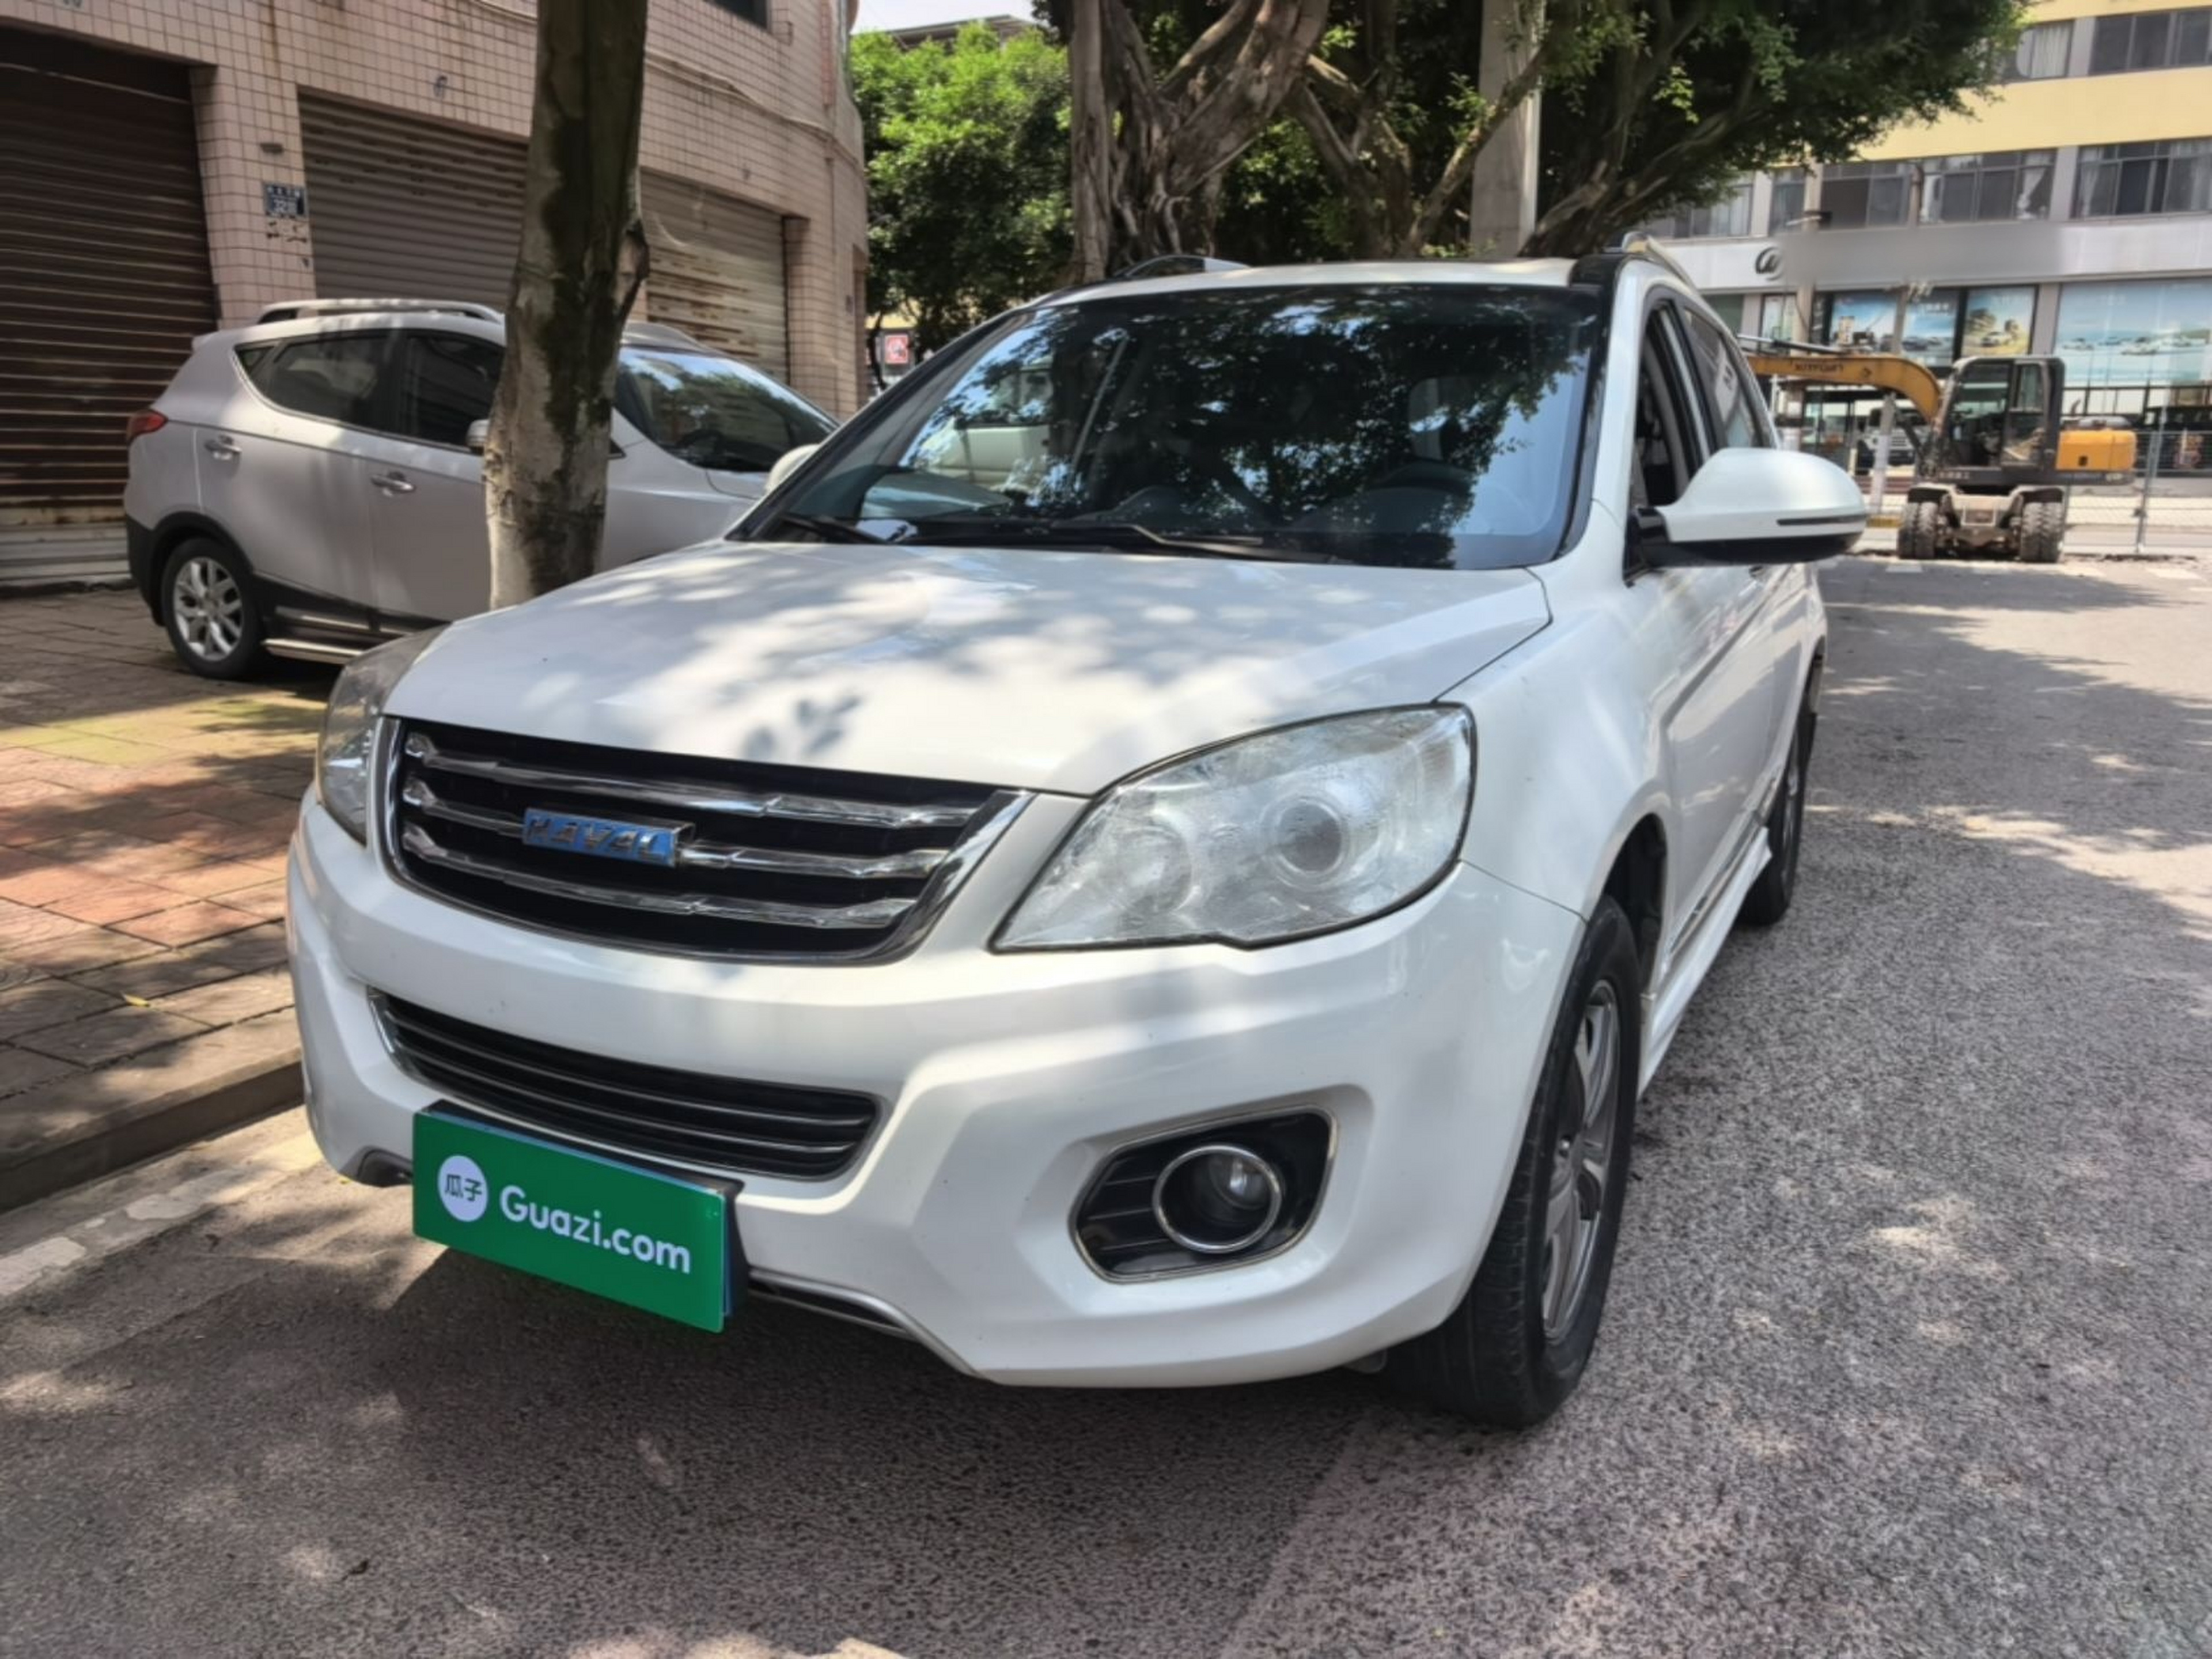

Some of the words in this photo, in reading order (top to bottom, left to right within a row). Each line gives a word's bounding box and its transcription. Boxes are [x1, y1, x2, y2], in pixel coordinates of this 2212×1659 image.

[527, 817, 666, 860] HAVAL
[445, 1173, 483, 1202] 瓜子
[499, 1185, 691, 1275] Guazi.com
